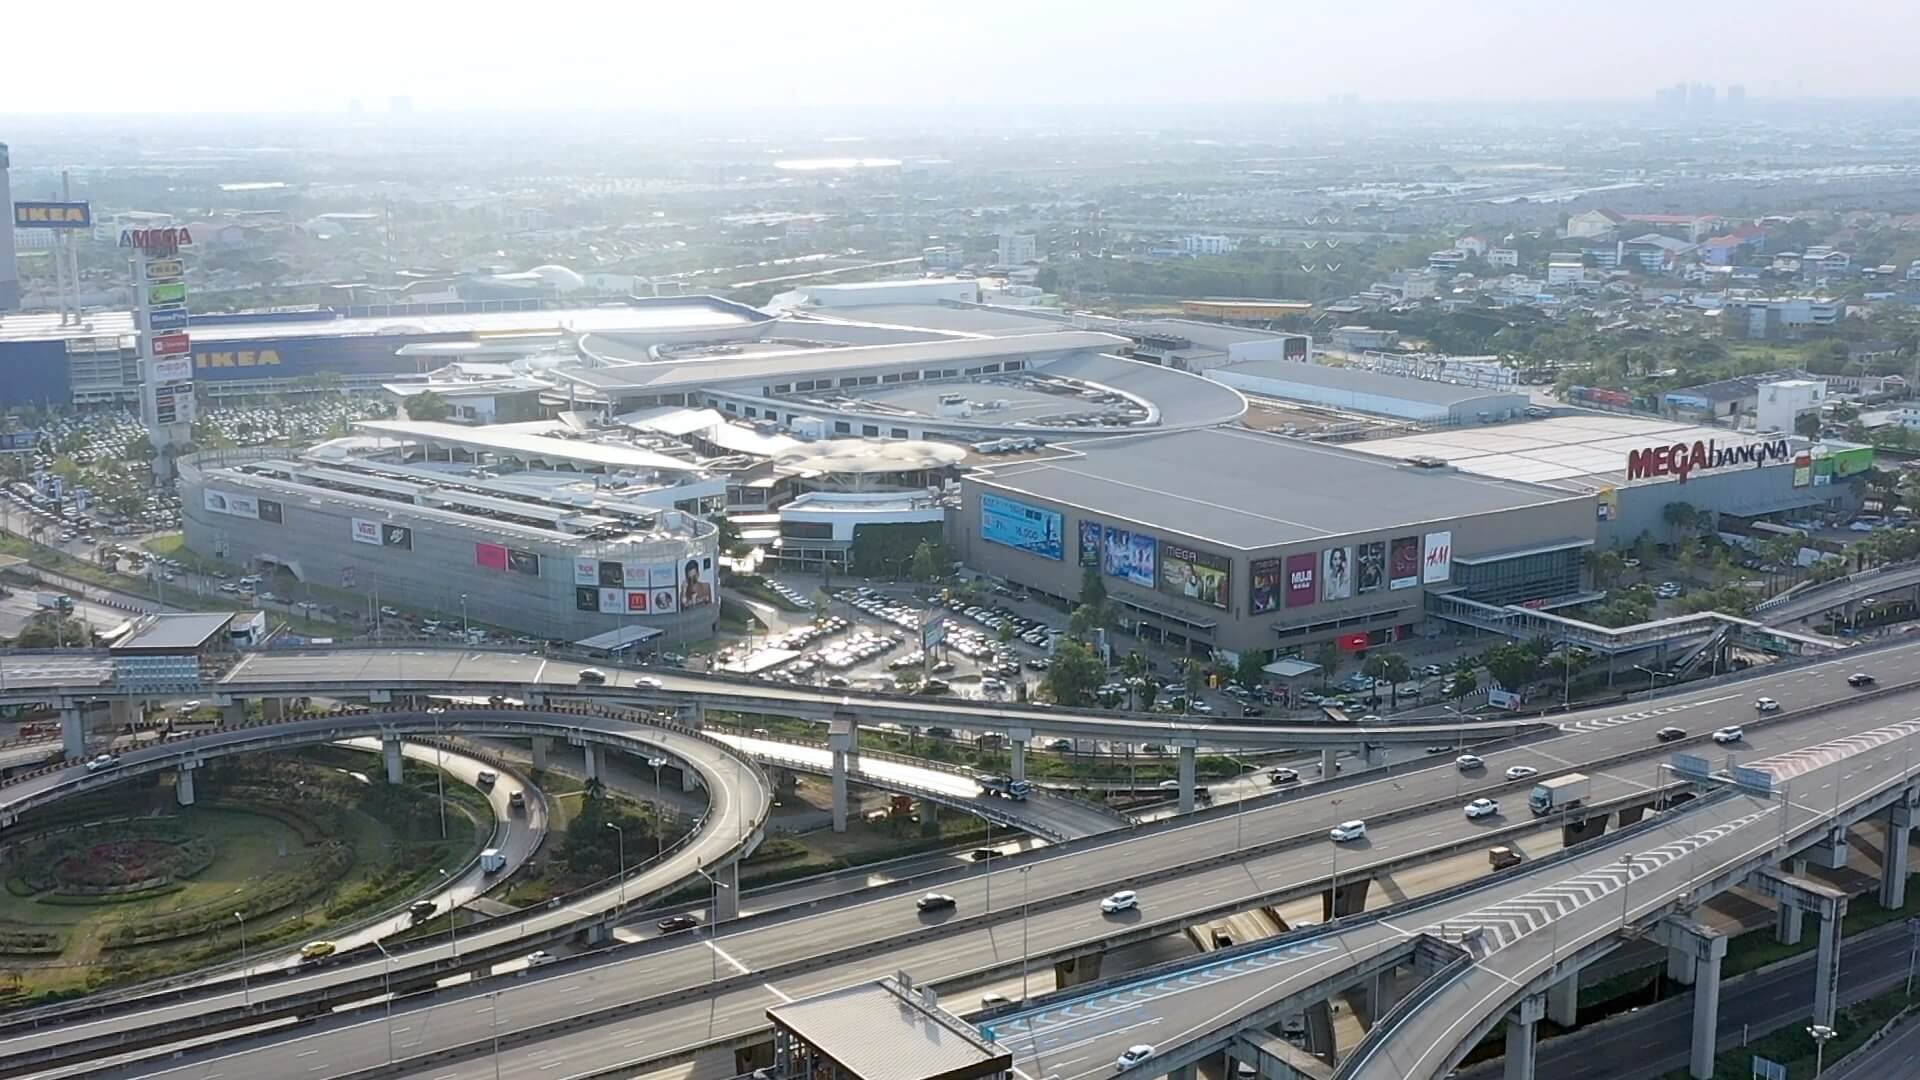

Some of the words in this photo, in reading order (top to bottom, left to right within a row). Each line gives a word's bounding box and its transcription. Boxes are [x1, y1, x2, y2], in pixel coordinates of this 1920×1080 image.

[18, 207, 84, 222] IKEA
[196, 350, 280, 368] IKEA
[1628, 440, 1707, 484] MEGA
[1167, 545, 1197, 562] MEGA
